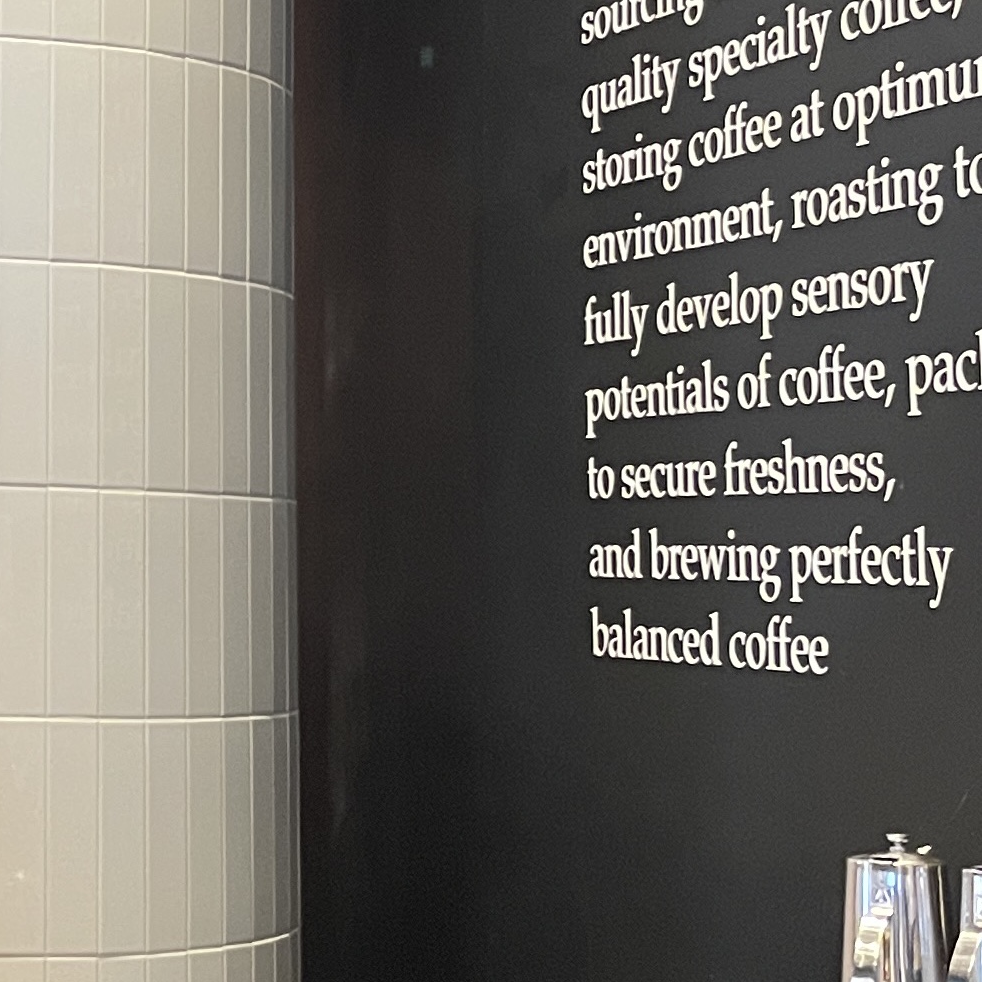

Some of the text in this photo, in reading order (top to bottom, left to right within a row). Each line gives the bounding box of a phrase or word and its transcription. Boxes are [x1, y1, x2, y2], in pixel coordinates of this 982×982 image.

[581, 53, 682, 134] quality
[688, 2, 833, 102] specialty
[582, 55, 982, 194] storing coffee at optimu
[583, 187, 784, 269] environment,
[790, 156, 945, 226] roasting
[583, 258, 935, 357] fully develop sensory
[584, 328, 982, 439] potentials of coffee, pac
[586, 437, 897, 502] to secure freshness,
[588, 525, 955, 609] and brewing perfectly
[589, 606, 830, 675] balanced coffee
